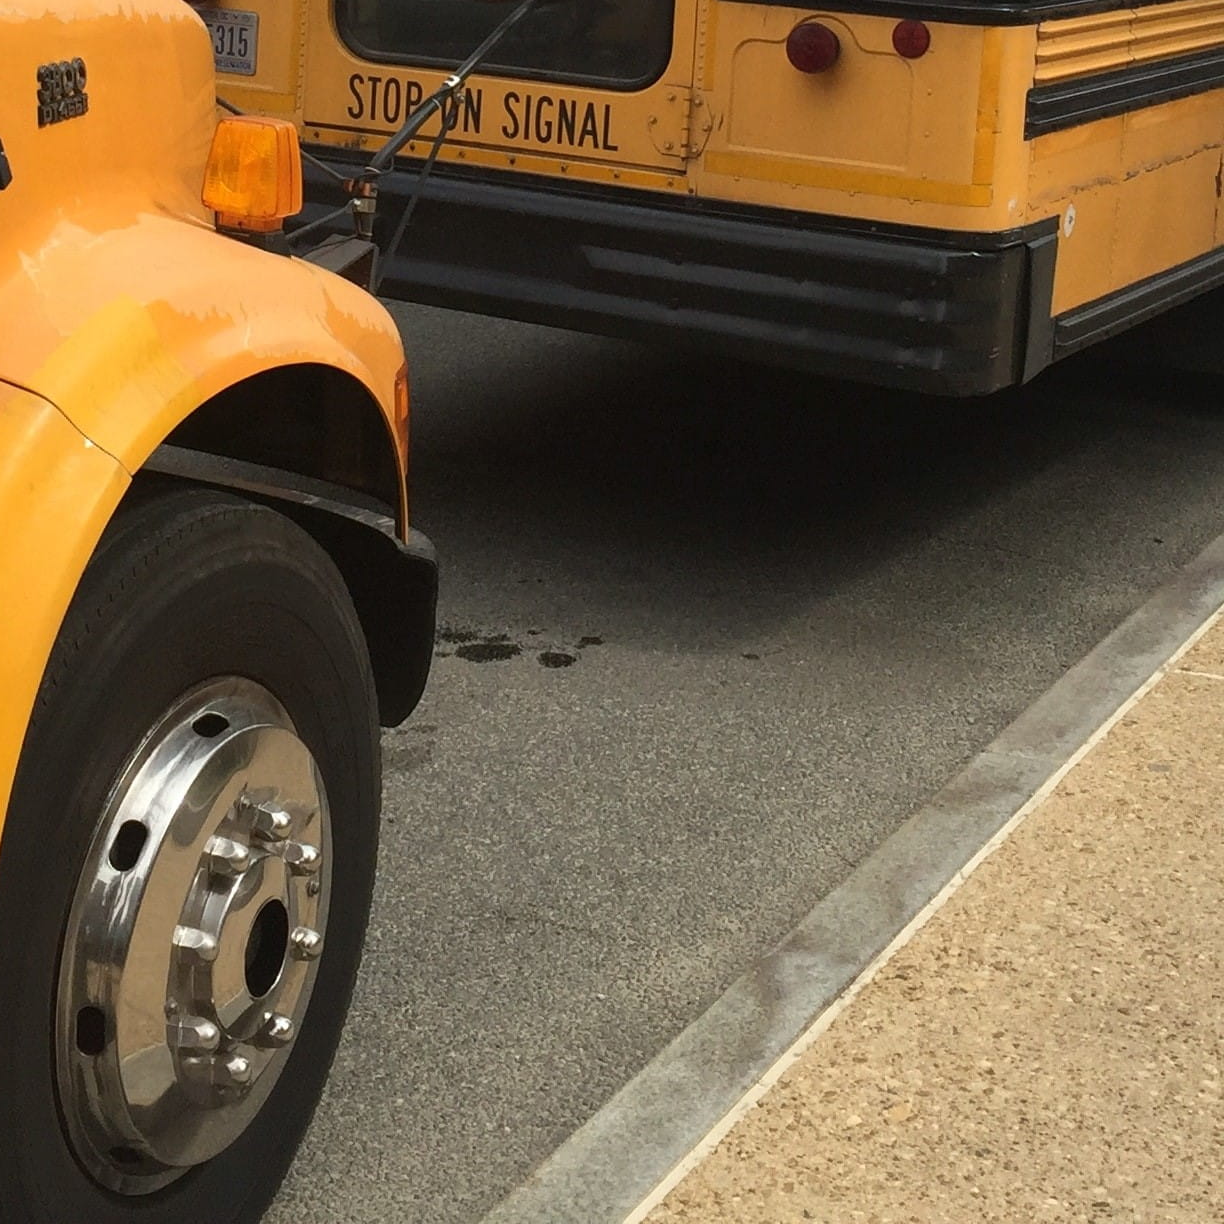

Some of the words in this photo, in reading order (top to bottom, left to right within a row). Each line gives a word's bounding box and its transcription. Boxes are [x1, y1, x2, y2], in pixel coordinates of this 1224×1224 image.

[206, 23, 249, 58] 315
[347, 73, 424, 124] STOP
[501, 91, 618, 152] SIGNAL
